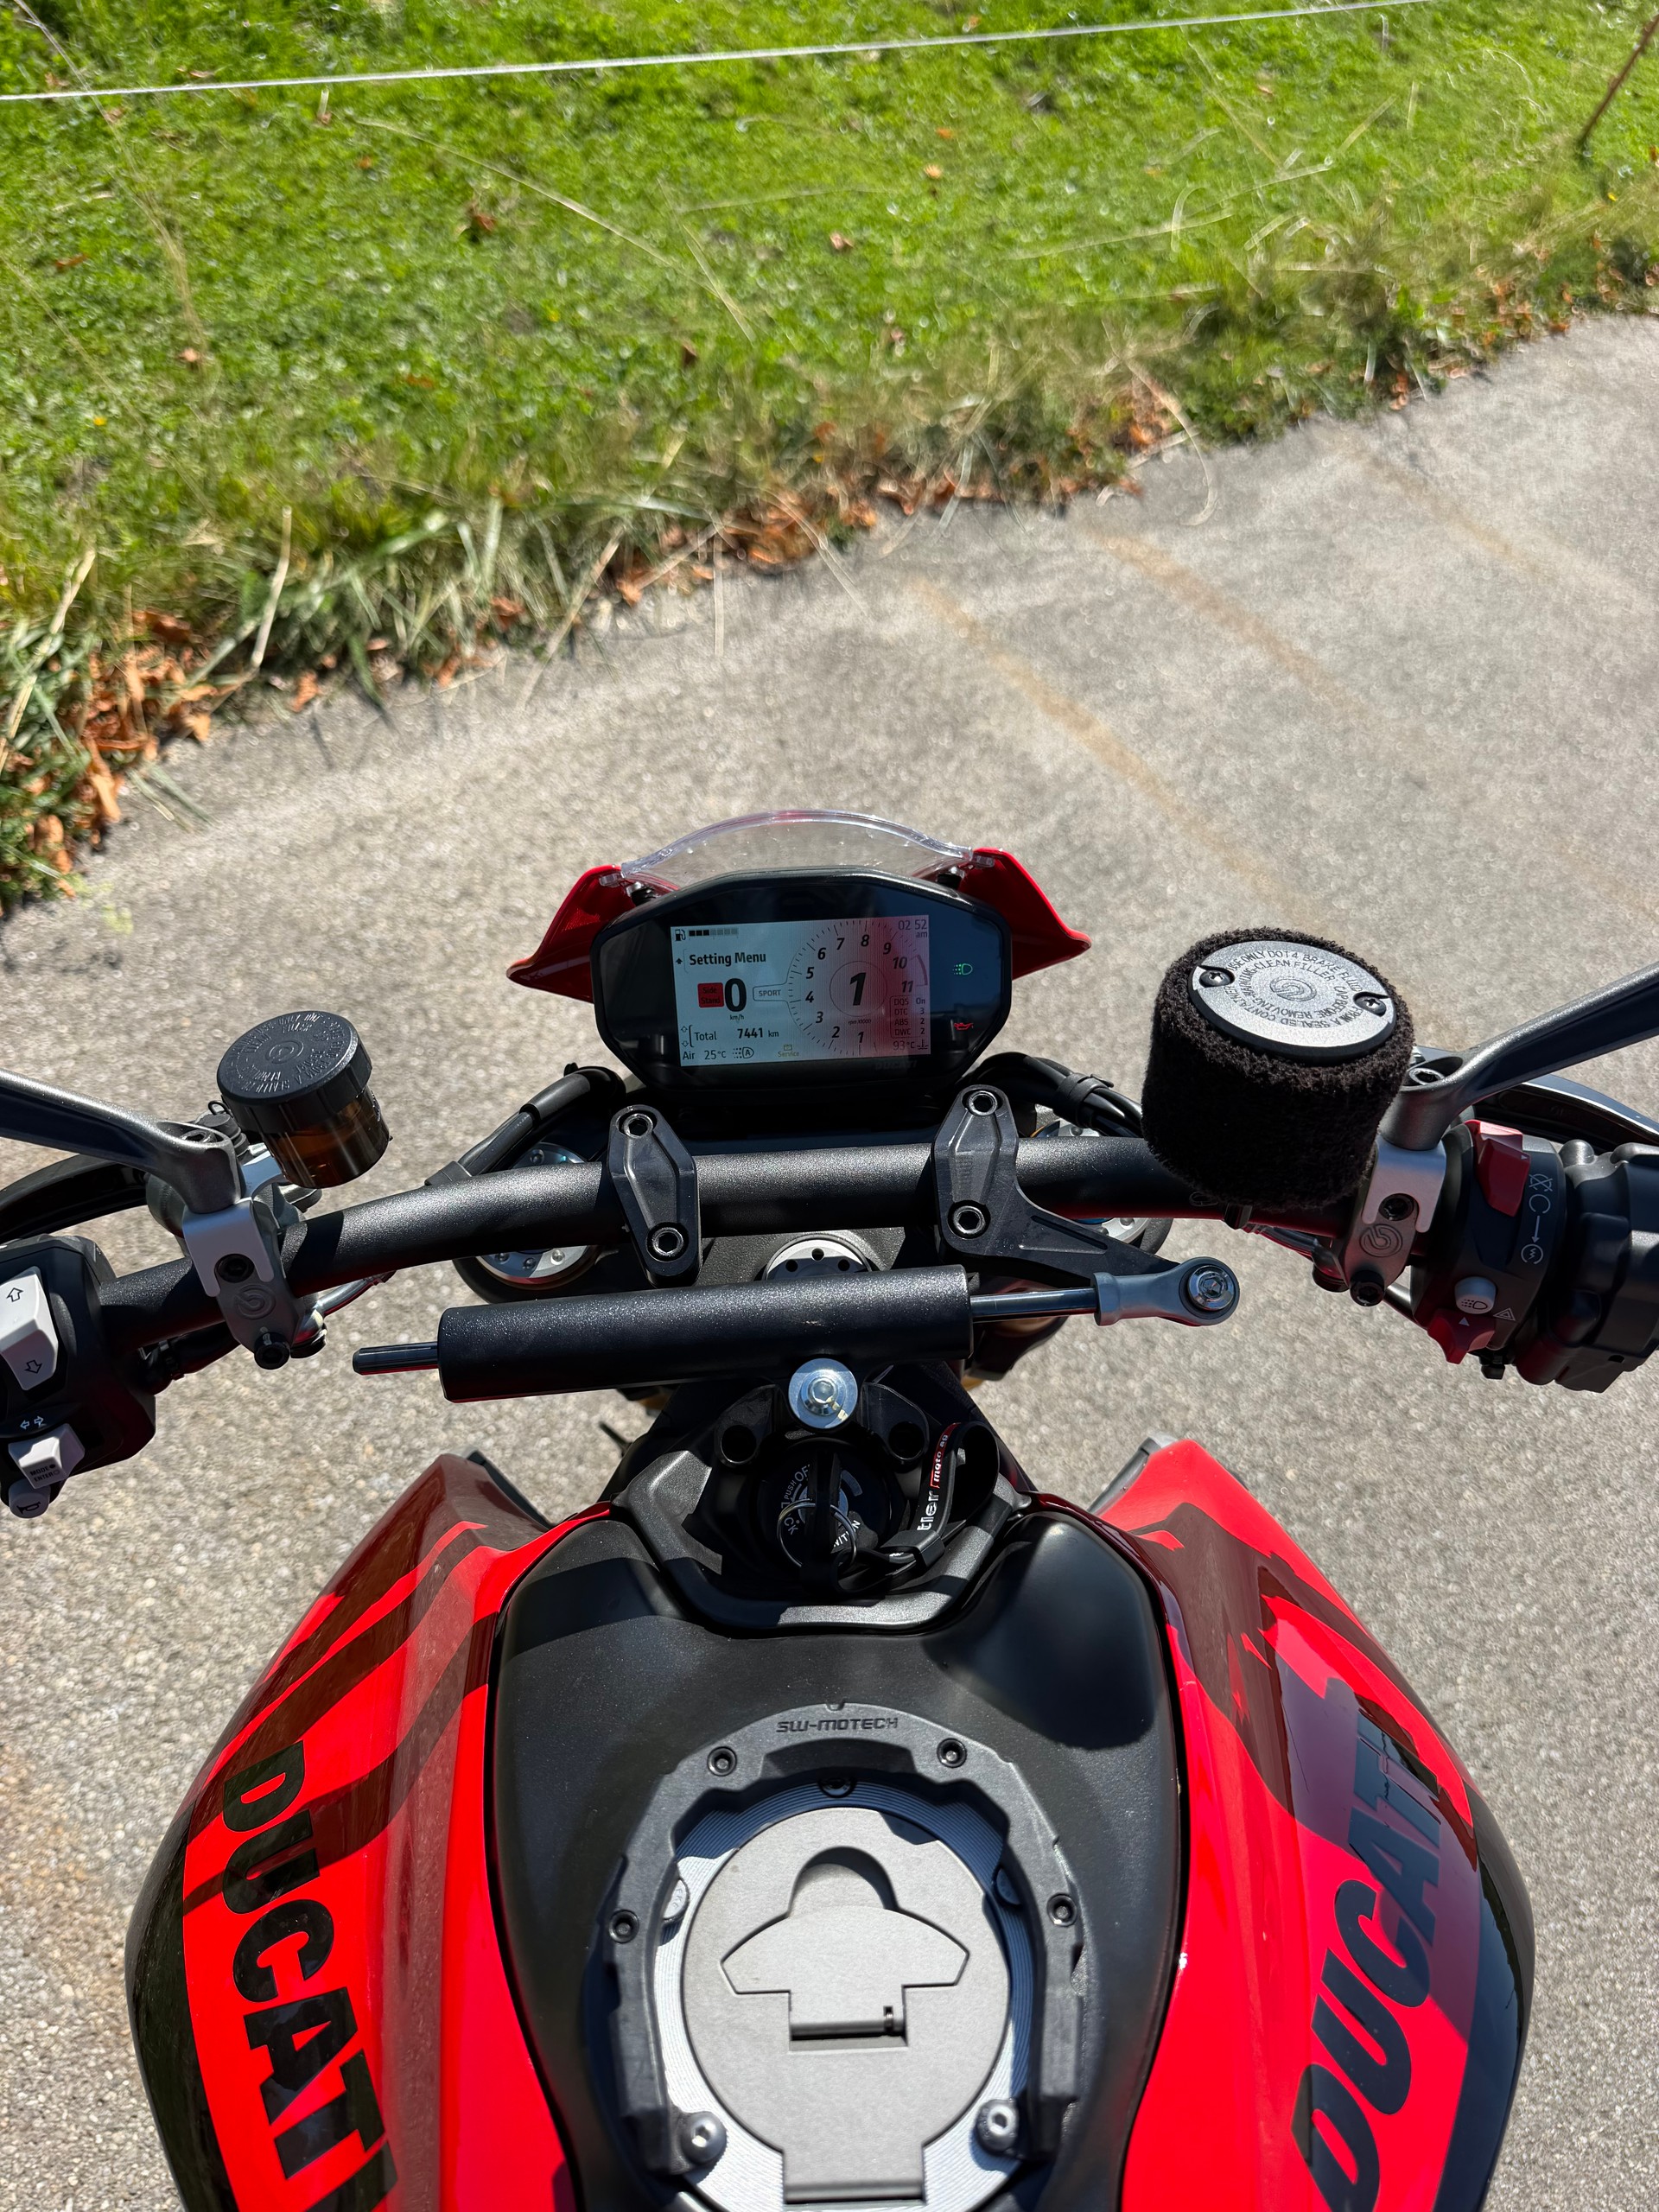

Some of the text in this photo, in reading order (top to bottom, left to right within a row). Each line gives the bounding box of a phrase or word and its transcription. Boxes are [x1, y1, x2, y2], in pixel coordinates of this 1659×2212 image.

[836, 938, 845, 950] 7
[861, 934, 869, 947] 8
[817, 947, 826, 960] 6
[883, 942, 892, 955] 9
[690, 952, 766, 967] Setting Menu
[893, 957, 907, 969] 10
[1240, 950, 1266, 963] ONLY
[1303, 954, 1342, 973] BRAKE
[805, 967, 815, 979] 5
[1294, 961, 1335, 982] FILLER
[901, 980, 914, 993] 11
[1338, 971, 1363, 992] FLUID
[725, 978, 747, 1012] 0
[849, 972, 867, 1006] 1
[1333, 986, 1349, 1000] CAP
[701, 996, 720, 1005] Stand
[805, 990, 815, 1003] 4
[1224, 986, 1276, 1021] CONTAINER
[1313, 999, 1348, 1019] BEFORE
[815, 1011, 823, 1024] 3
[894, 1007, 908, 1016] DTC
[1339, 1006, 1363, 1023] FROM
[1281, 1018, 1331, 1029] SEALED
[695, 1031, 717, 1041] Total
[737, 1027, 763, 1039] 7441
[831, 1026, 841, 1039] 2
[857, 1032, 865, 1044] 1
[683, 1051, 695, 1060] Air
[933, 1451, 942, 1482] moto
[939, 1434, 949, 1448] ag
[29, 1466, 48, 1476] MODE
[34, 1471, 54, 1482] ENTER
[794, 1464, 810, 1482] OF
[784, 1479, 797, 1500] PUSH
[780, 1502, 798, 1535] LCK
[776, 1717, 899, 1732] SW-MOTECH
[1291, 1708, 1441, 2212] DUCATI
